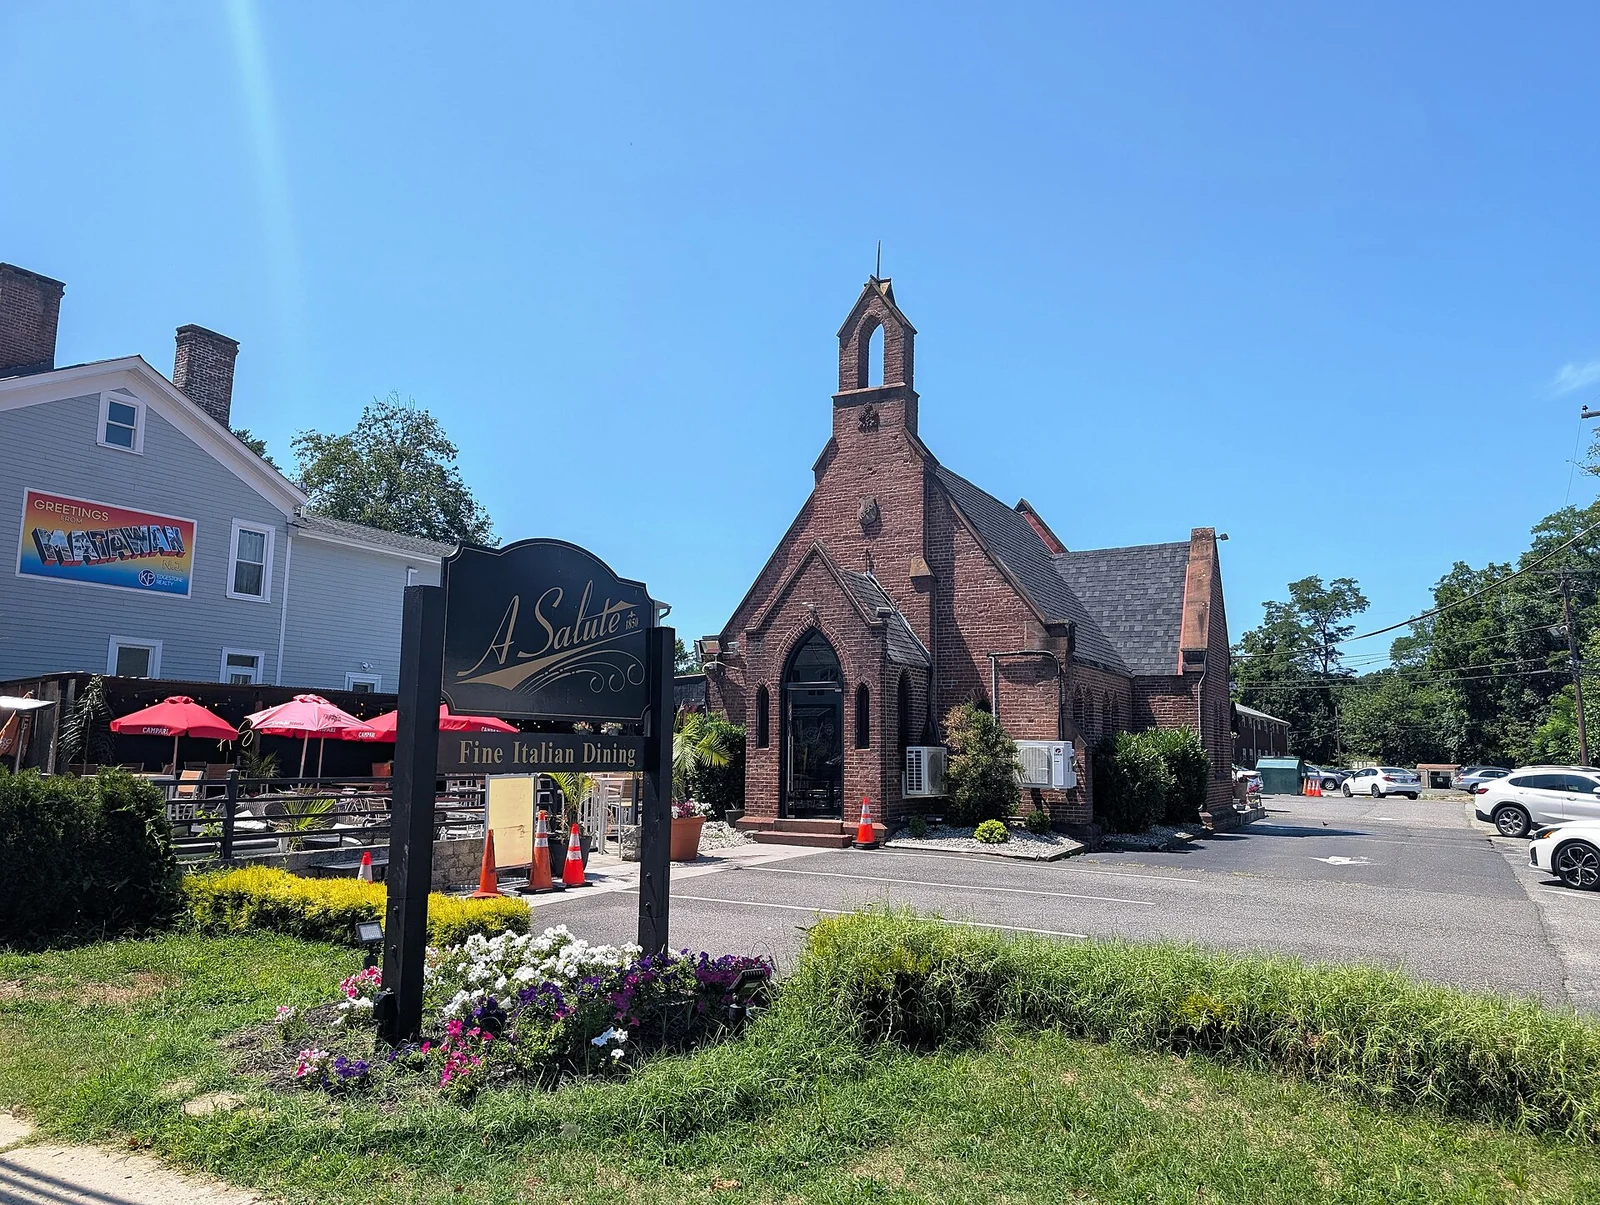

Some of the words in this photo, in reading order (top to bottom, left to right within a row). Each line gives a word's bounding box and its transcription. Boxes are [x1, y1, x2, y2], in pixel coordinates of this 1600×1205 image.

[33, 499, 109, 522] GREETINGS
[60, 514, 83, 525] FROM
[31, 525, 186, 567] MATAWAN
[456, 595, 519, 677] A
[517, 579, 622, 658] Salute
[142, 727, 169, 735] CAMPARI
[458, 740, 504, 764] Fine
[512, 741, 575, 764] Italian
[582, 742, 637, 768] Dining
